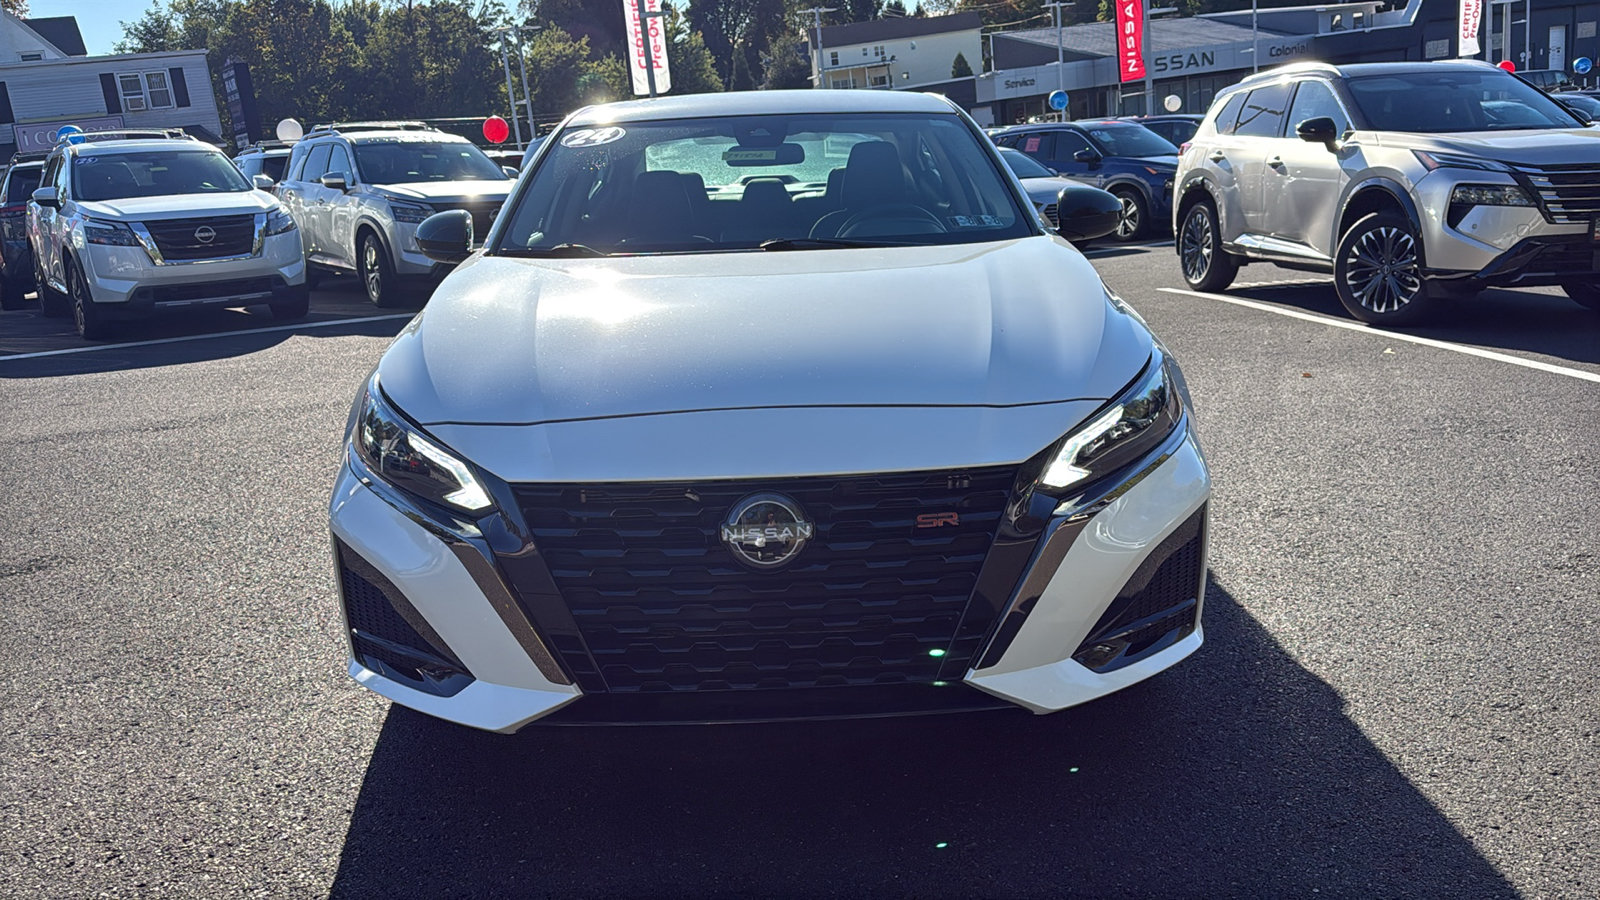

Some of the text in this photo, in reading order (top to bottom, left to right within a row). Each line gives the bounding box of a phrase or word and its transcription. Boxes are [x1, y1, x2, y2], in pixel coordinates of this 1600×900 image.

[1470, 0, 1480, 38] Pre-Ow
[1124, 0, 1138, 72] NISSA
[1269, 43, 1309, 57] Colonial
[1154, 50, 1215, 72] SSAN
[1004, 78, 1035, 89] Service
[566, 127, 617, 146] 24
[917, 512, 960, 528] SR
[723, 525, 811, 541] NISSAN
